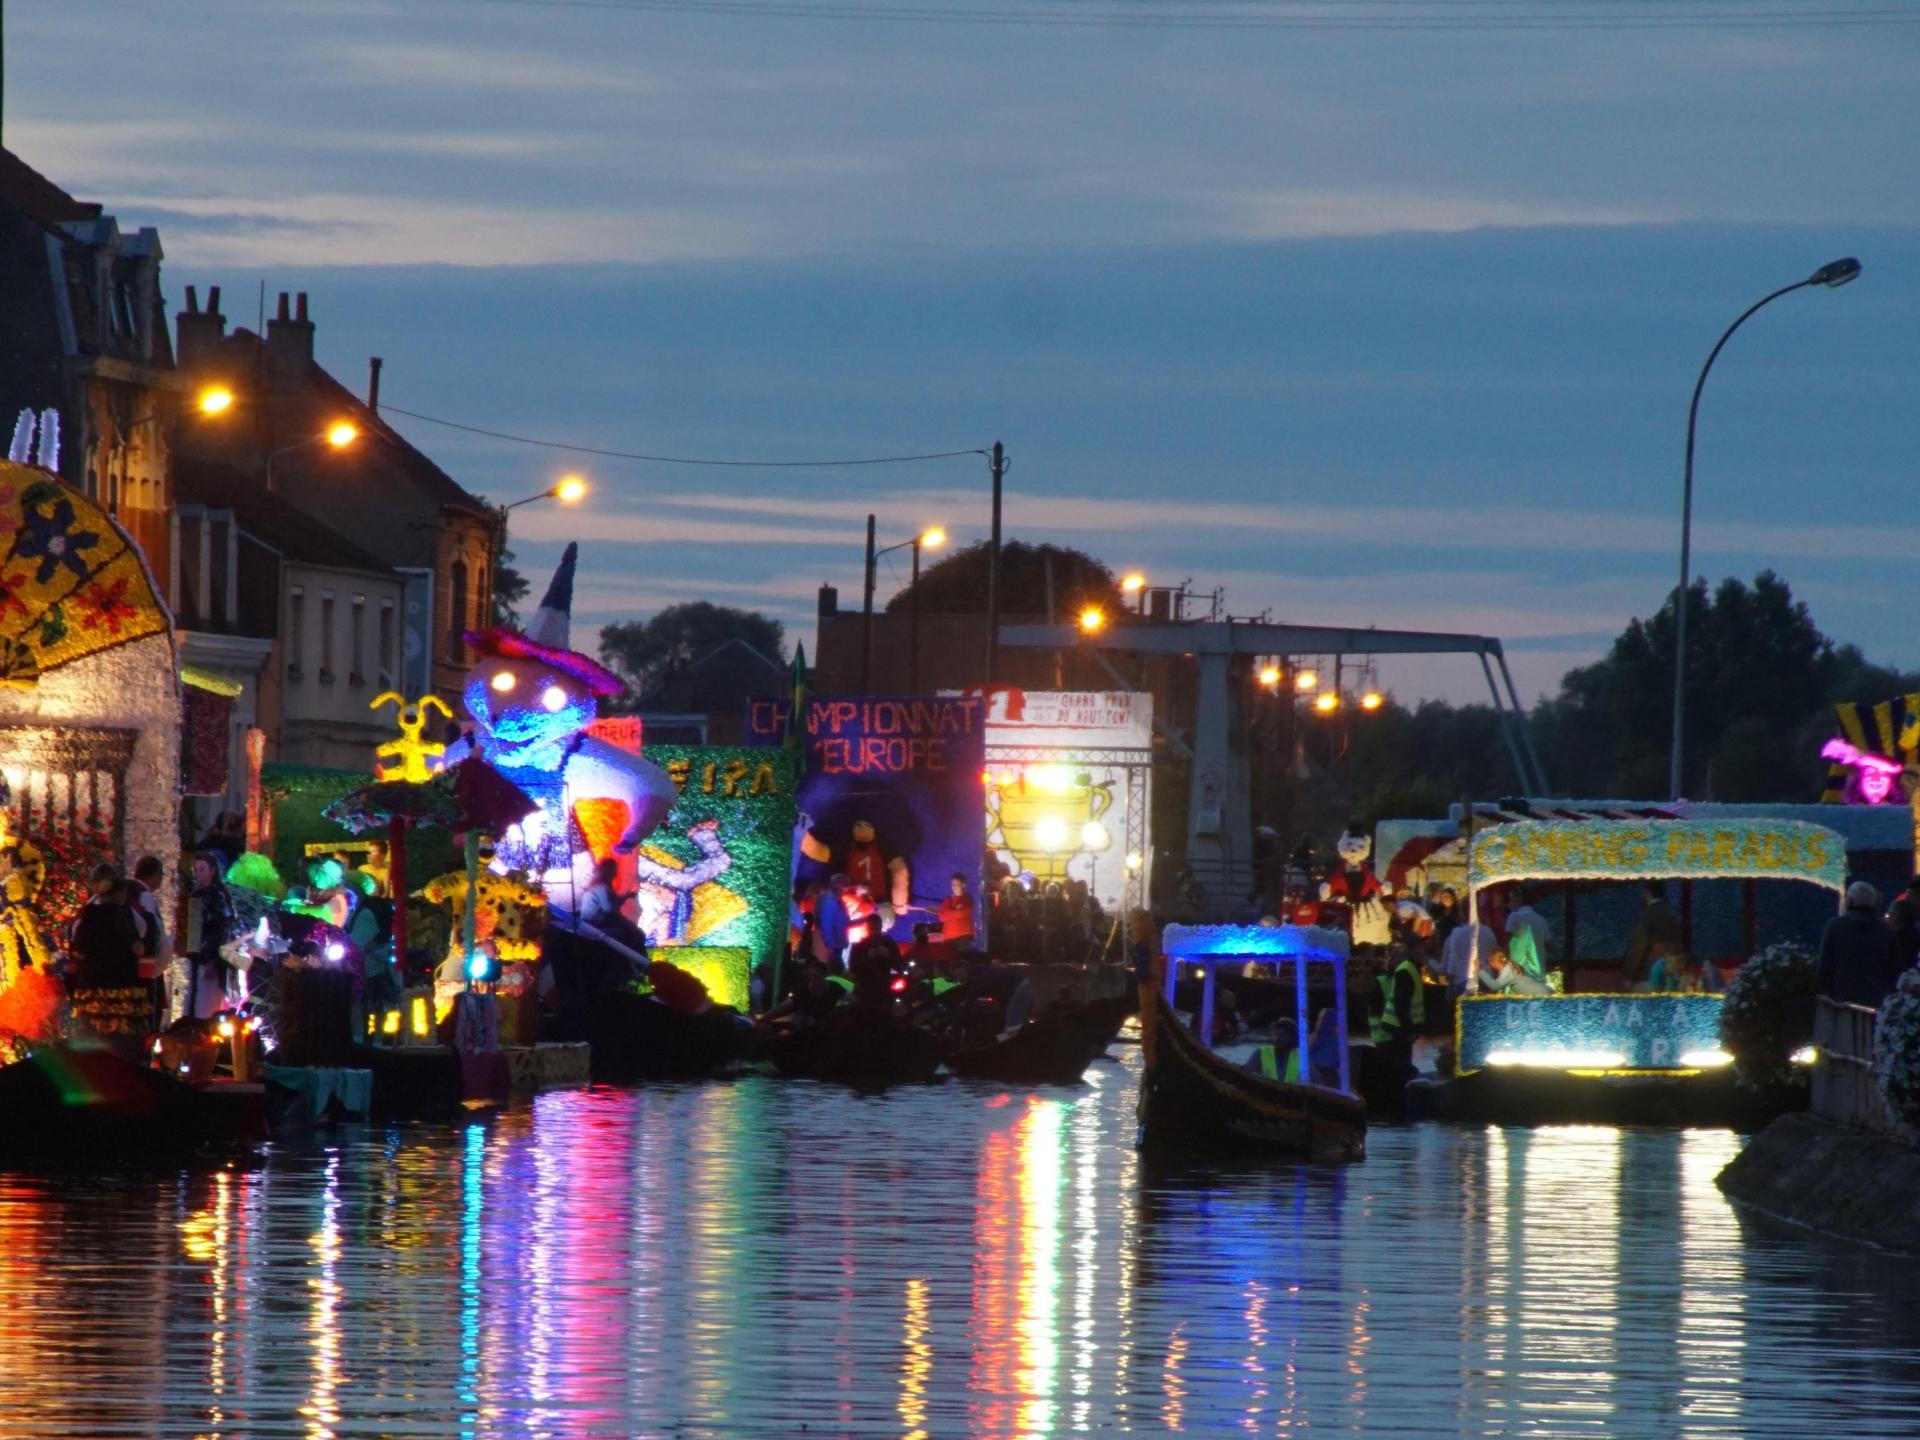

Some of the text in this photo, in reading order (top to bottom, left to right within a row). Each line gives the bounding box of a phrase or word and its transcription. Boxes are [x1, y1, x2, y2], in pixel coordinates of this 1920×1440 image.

[815, 737, 948, 774] 'EUROPE
[1475, 829, 1829, 875] CAMPING PARADIS
